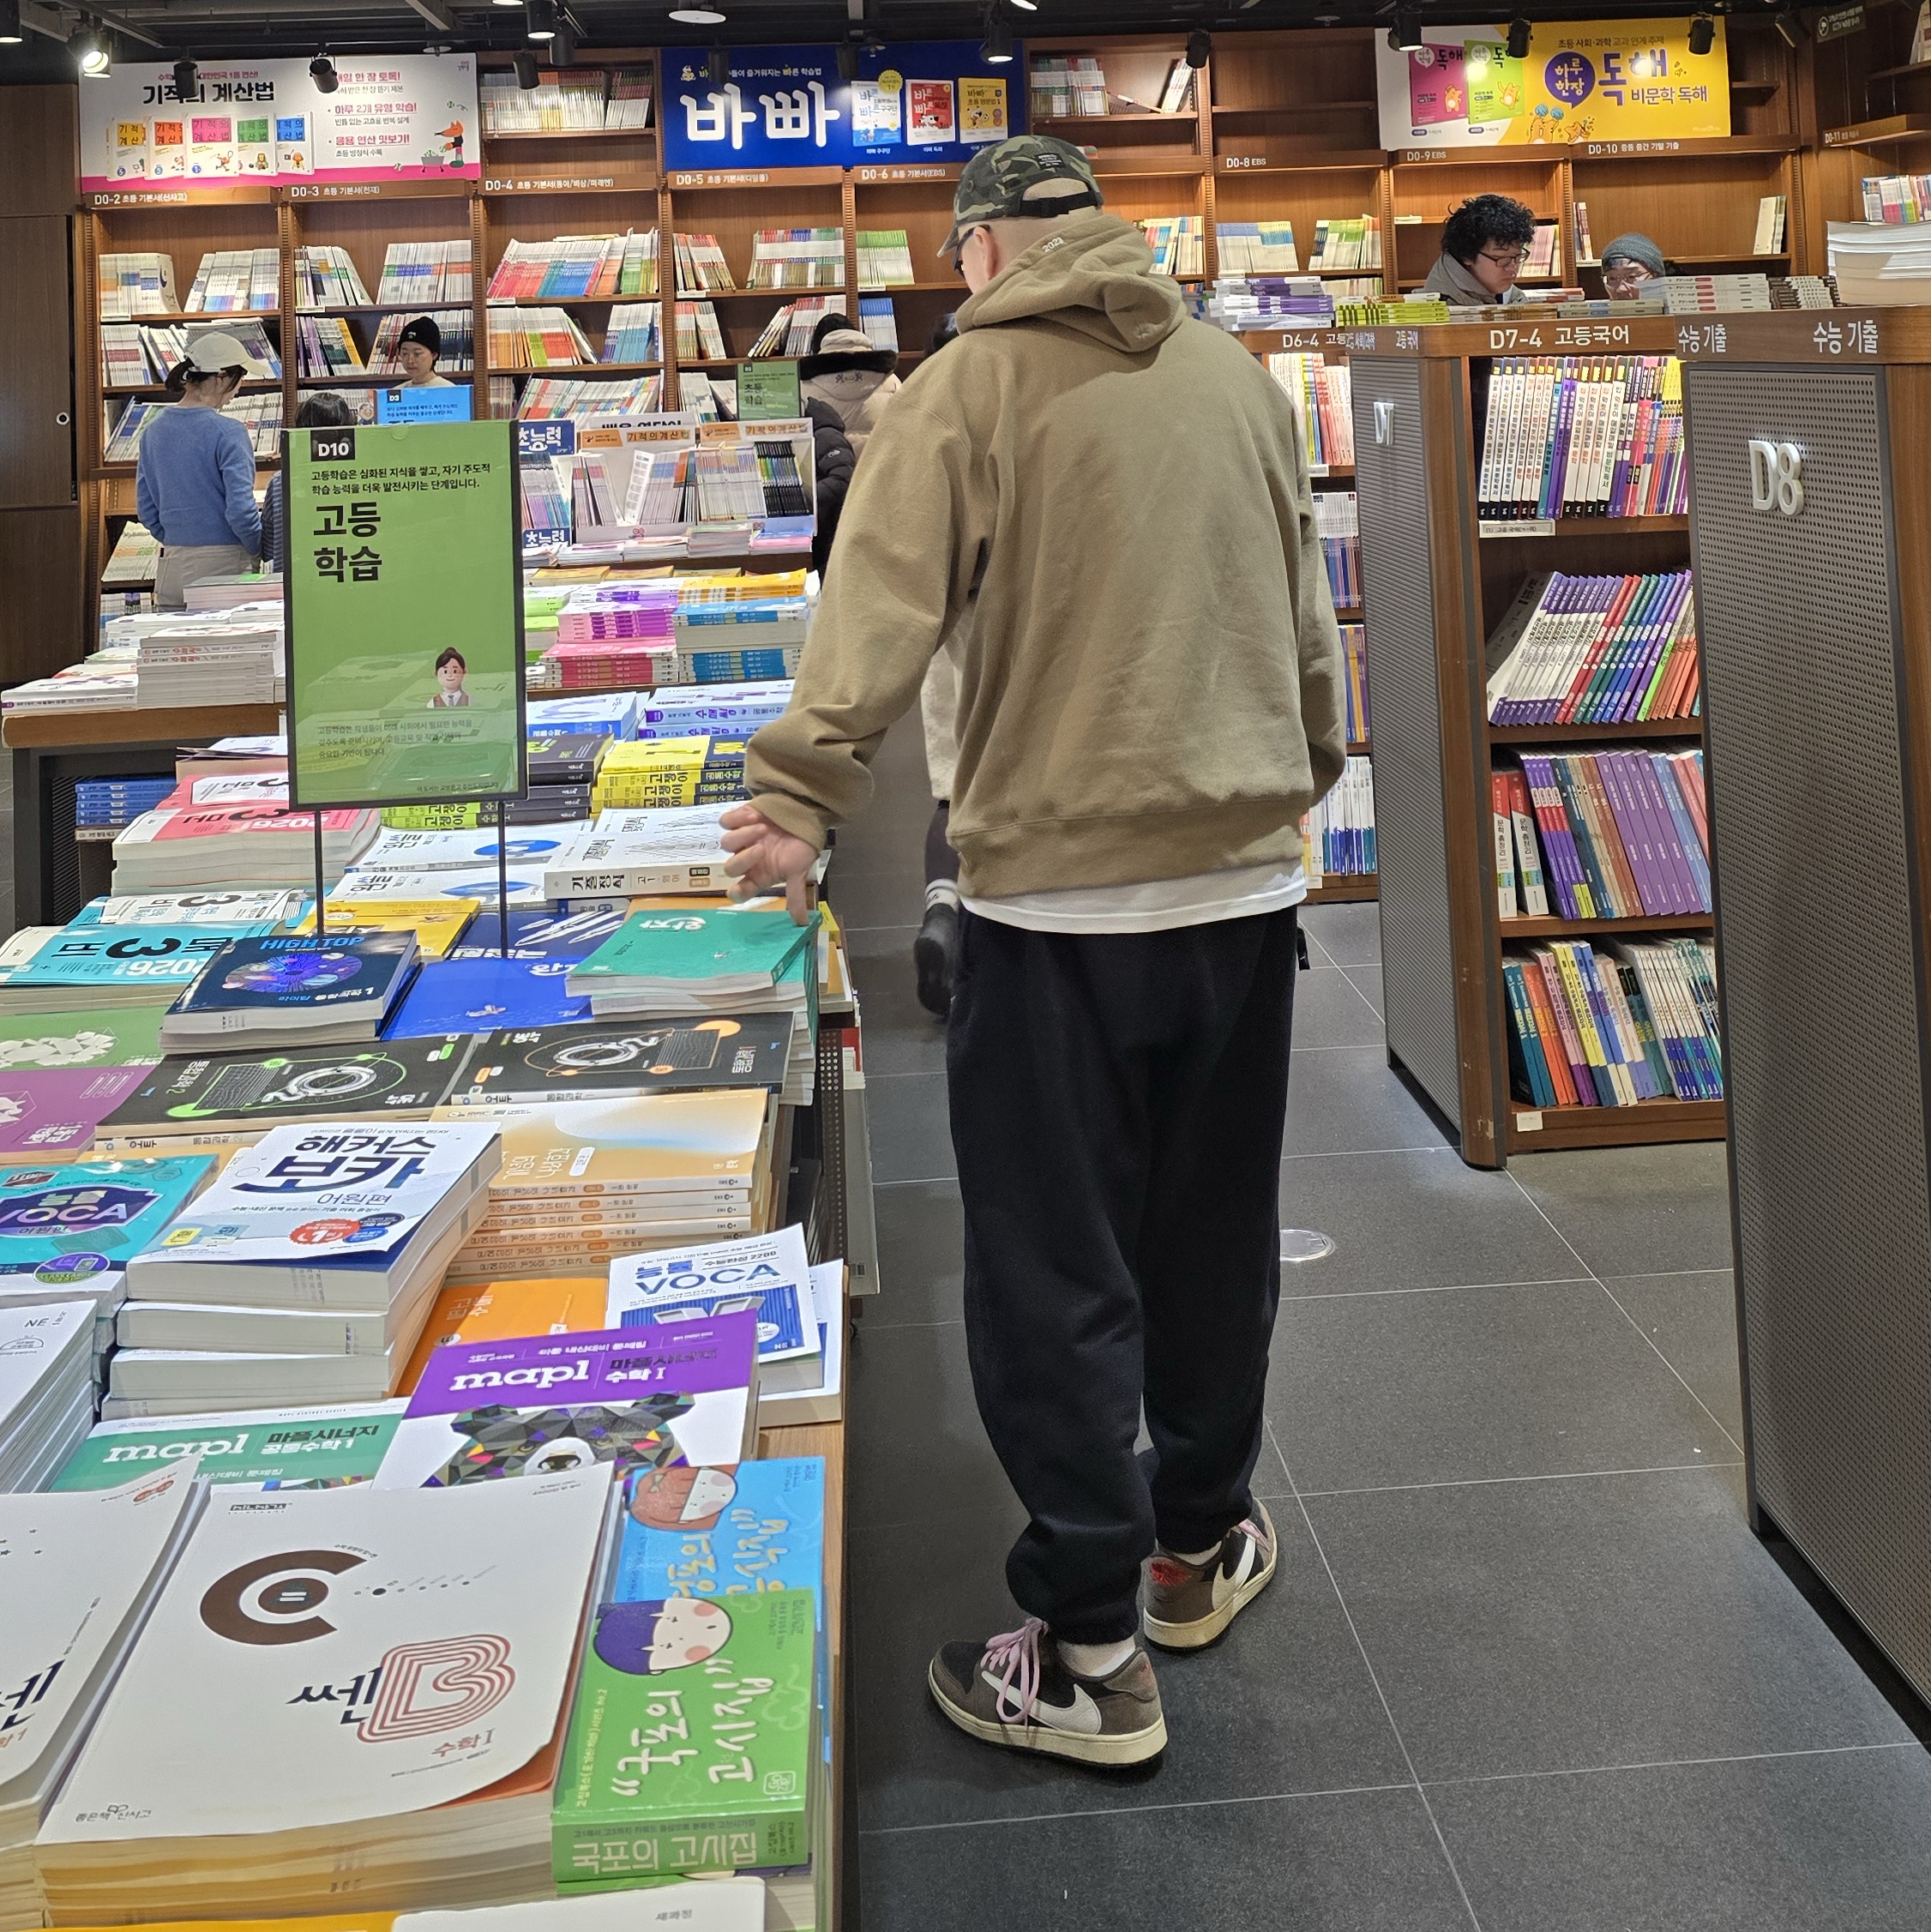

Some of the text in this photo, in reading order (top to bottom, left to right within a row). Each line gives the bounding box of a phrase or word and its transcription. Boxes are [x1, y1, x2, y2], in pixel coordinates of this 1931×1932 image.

[1555, 57, 1584, 79] 하루
[213, 81, 274, 102] 계산법
[1555, 77, 1585, 96] 한장
[1631, 86, 1707, 105] 비문학 독해
[680, 81, 840, 149] 바빠
[378, 134, 410, 144] 맛보기!
[1406, 152, 1430, 162] D0-9
[1588, 144, 1618, 155] D0-10
[1226, 158, 1266, 168] D0-8 EBS
[676, 174, 703, 185] D0-5
[862, 169, 888, 180] D0-6
[291, 186, 319, 197] D0-3
[485, 179, 513, 191] D0-4
[94, 194, 121, 205] D0-2
[1283, 334, 1319, 347] D6-4
[1490, 325, 1629, 349] D7-4 고등국어
[1678, 323, 1727, 353] 수능 기출
[1813, 318, 1878, 353] 수능 기출
[744, 383, 762, 394] 초등
[744, 395, 762, 405] 학습
[318, 442, 349, 456] D10
[311, 464, 490, 481] 고등학습은 심화된 지식을 쌓고, 자기 주도적
[1749, 440, 1803, 515] D8
[312, 478, 479, 496] 학습 능력을 더욱 발전시키는 단계입니다.
[313, 502, 381, 538] 고등
[314, 545, 382, 583] 학습
[650, 773, 688, 784] 고쟁이
[645, 784, 683, 796] 고쟁이
[428, 802, 468, 814] 고쟁이
[424, 815, 464, 828] 고쟁이
[572, 872, 625, 890] 기출정식
[260, 936, 365, 949] HIGH TOP
[295, 1136, 439, 1154] 해커스
[231, 1155, 426, 1193] 보카
[316, 1193, 393, 1206] 어원편
[635, 1260, 693, 1279] 능률
[750, 1251, 777, 1260] 2200
[635, 1263, 780, 1295] VOCA
[24, 1318, 50, 1328] NE
[448, 1359, 589, 1392] mapl
[605, 1368, 652, 1383] 수학
[102, 1424, 380, 1464] mapl 마플시너지
[285, 1666, 382, 1724] 쎈
[431, 1734, 481, 1758] 수학
[75, 1809, 152, 1823] 좋은책 신사고
[573, 1839, 659, 1875] 국포의
[671, 1833, 756, 1868] 고시집
